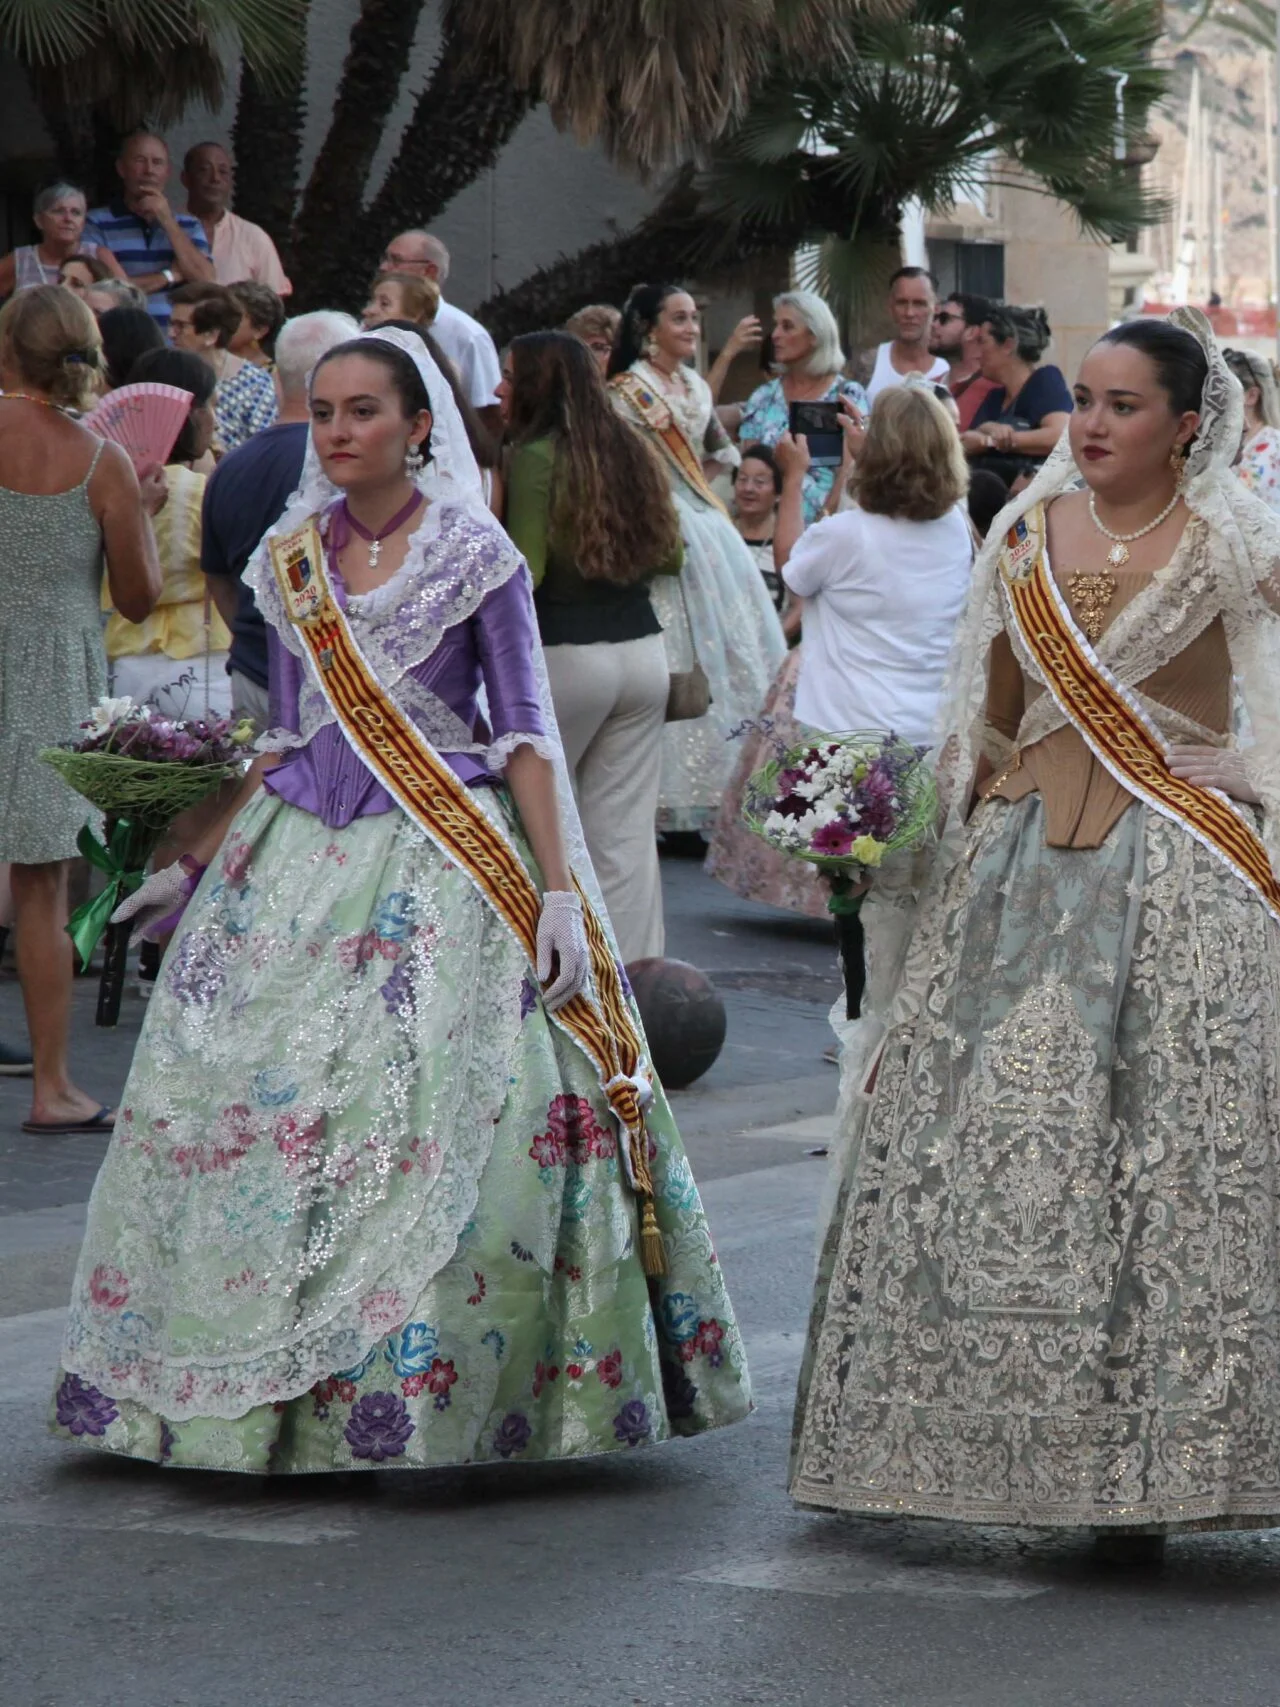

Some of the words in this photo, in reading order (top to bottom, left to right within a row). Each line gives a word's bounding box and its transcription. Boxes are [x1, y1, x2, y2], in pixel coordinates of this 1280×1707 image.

[1009, 539, 1032, 563] 2020
[294, 585, 317, 608] 2020
[1038, 632, 1089, 698] Cort
[351, 706, 410, 772] Cort
